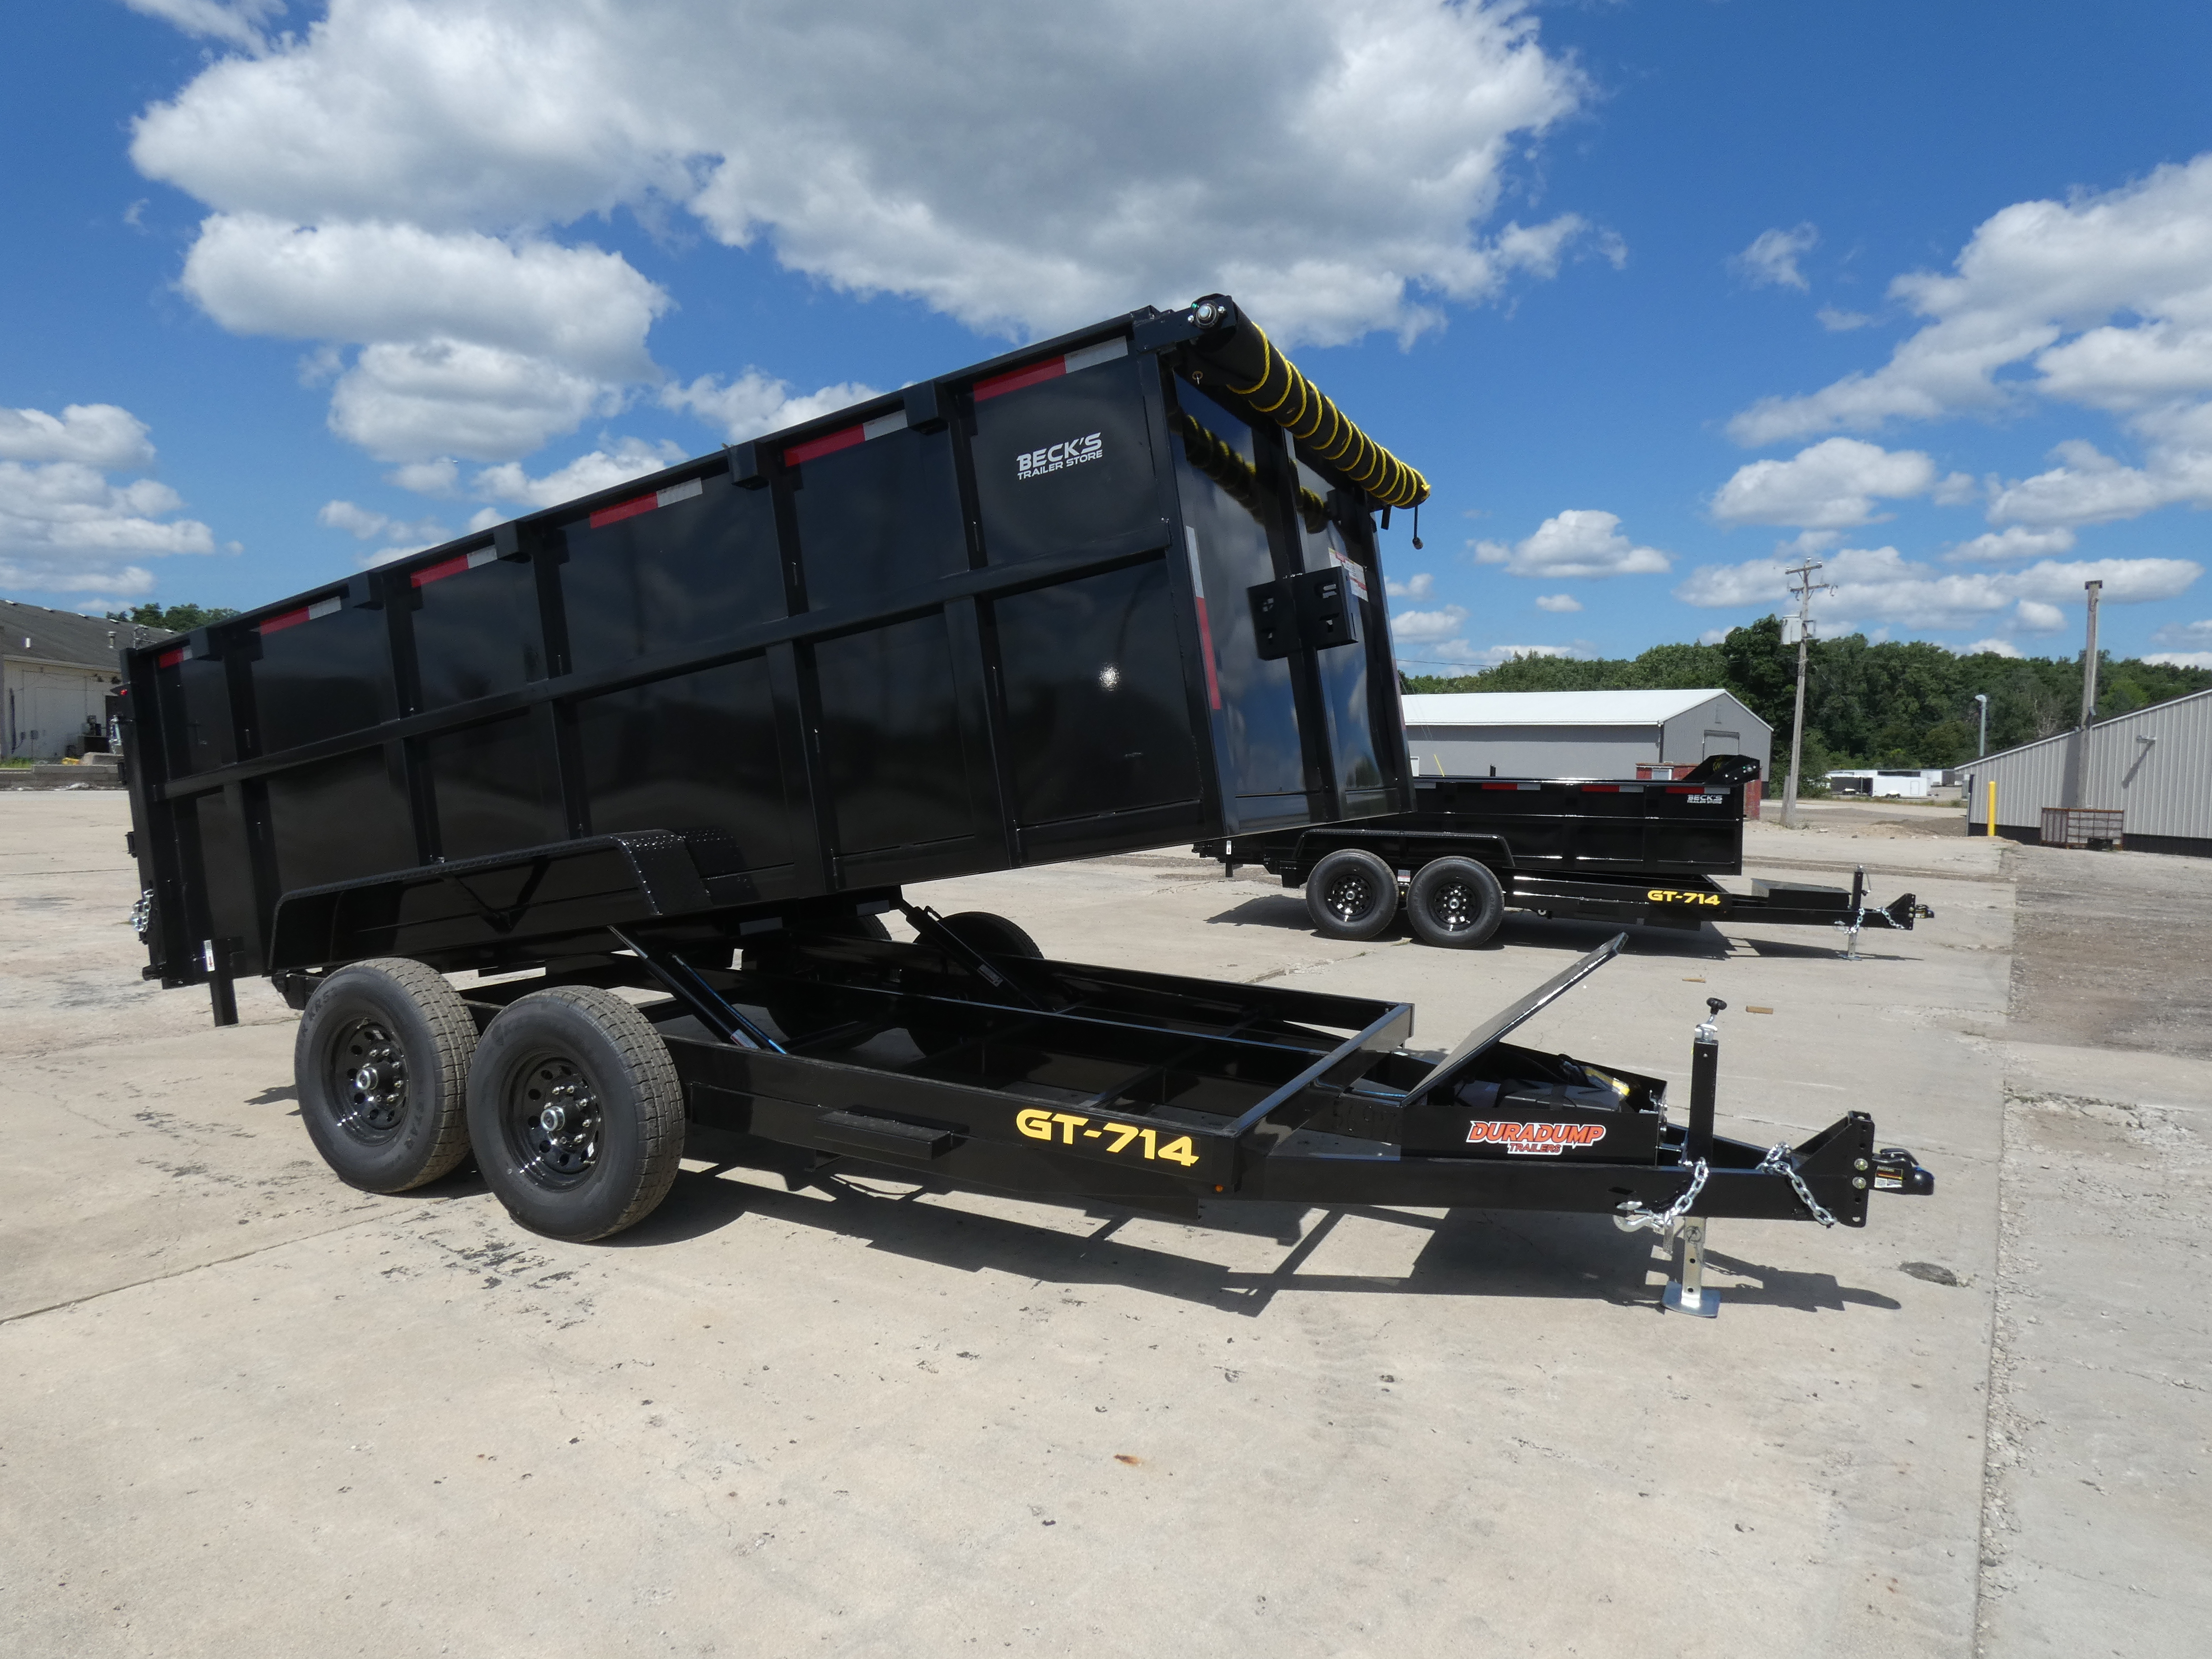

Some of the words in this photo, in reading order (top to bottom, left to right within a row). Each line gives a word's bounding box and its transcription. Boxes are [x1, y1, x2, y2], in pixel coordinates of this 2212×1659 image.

[1017, 432, 1102, 472] BECK'S
[1017, 462, 1063, 480] TRAILER
[1066, 449, 1103, 467] STORE
[1647, 890, 1721, 905] GT-714
[1016, 1109, 1200, 1167] GT-714
[1468, 1121, 1604, 1144] DURADUMP
[1509, 1143, 1561, 1153] TRAILERS
